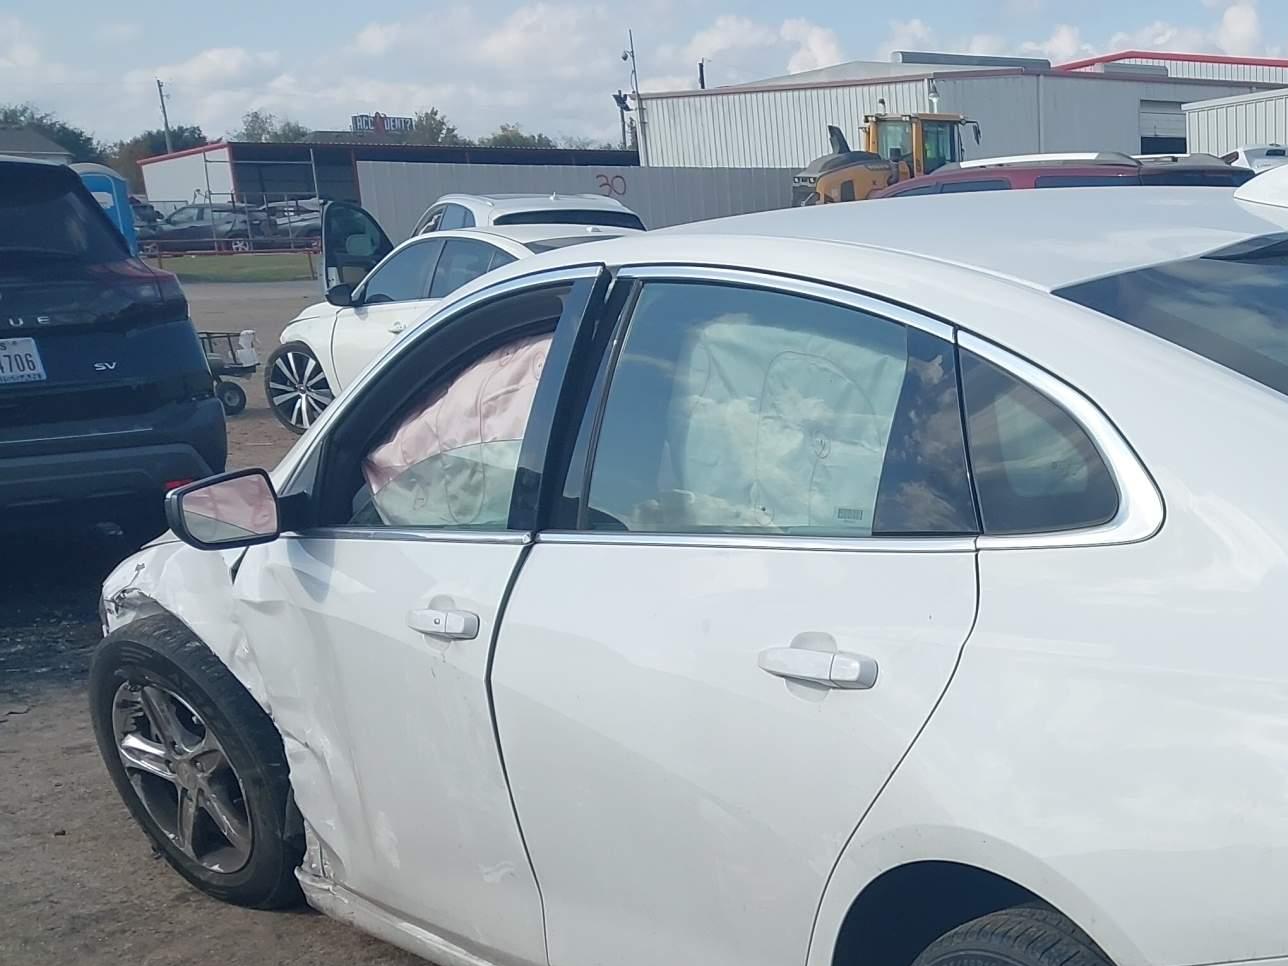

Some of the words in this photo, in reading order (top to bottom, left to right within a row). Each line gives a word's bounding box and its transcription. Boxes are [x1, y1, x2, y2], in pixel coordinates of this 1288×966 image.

[356, 117, 412, 130] ACCDENT?
[596, 174, 627, 196] 30
[94, 362, 117, 371] SV
